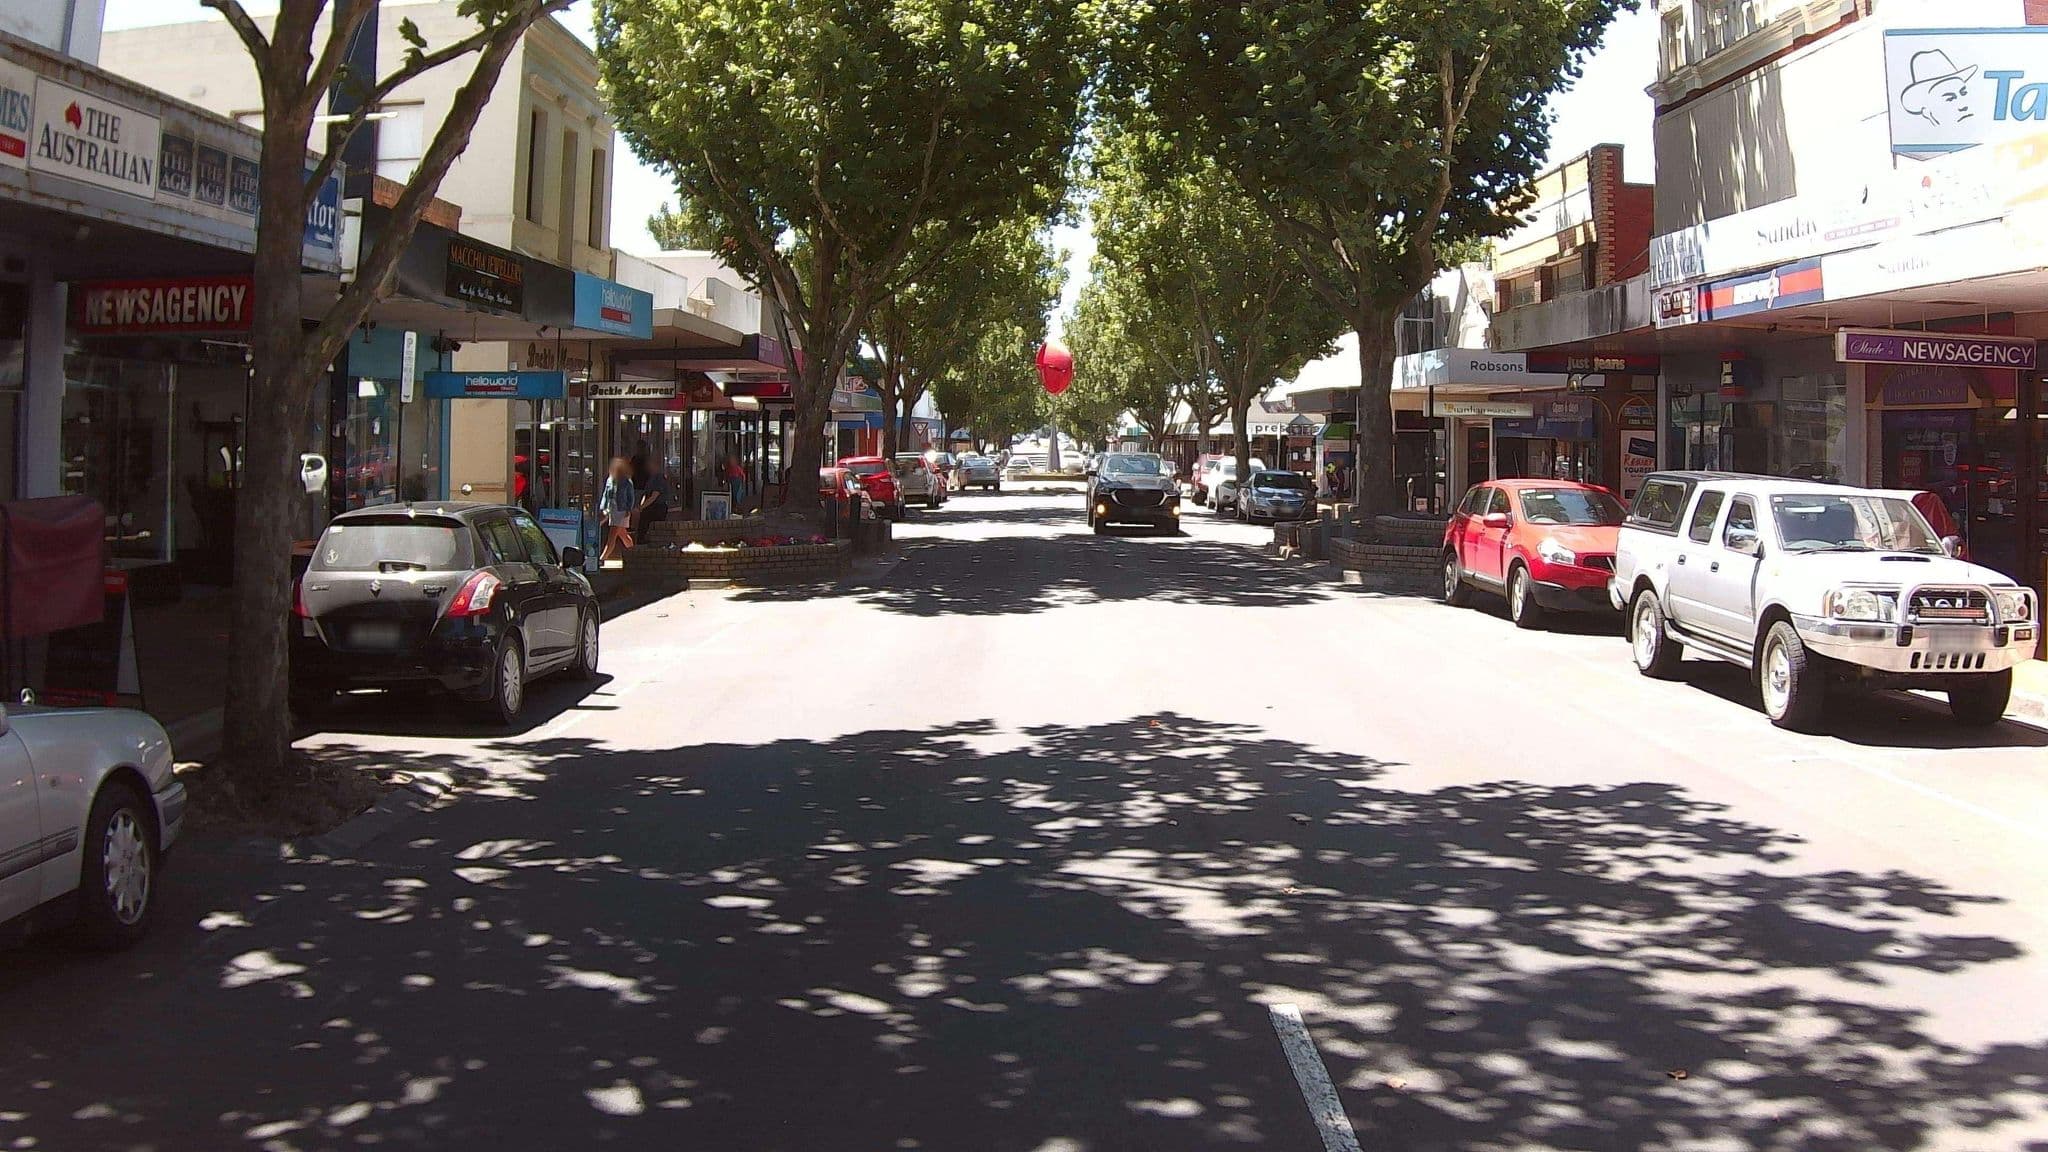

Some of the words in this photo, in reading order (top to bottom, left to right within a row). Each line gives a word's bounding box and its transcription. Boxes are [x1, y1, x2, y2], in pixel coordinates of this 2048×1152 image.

[86, 107, 121, 144] THE
[37, 121, 153, 186] AUSTRALIAN
[160, 172, 190, 193] AGE
[86, 285, 247, 326] NEWSAGENCY
[1903, 341, 2033, 364] NEWSAGENCY
[1470, 360, 1523, 372] Robsons
[1567, 356, 1590, 370] just
[1593, 356, 1625, 372] jeans
[465, 375, 518, 386] helloworld
[589, 384, 623, 396] Buckle
[624, 383, 675, 396] Menswear
